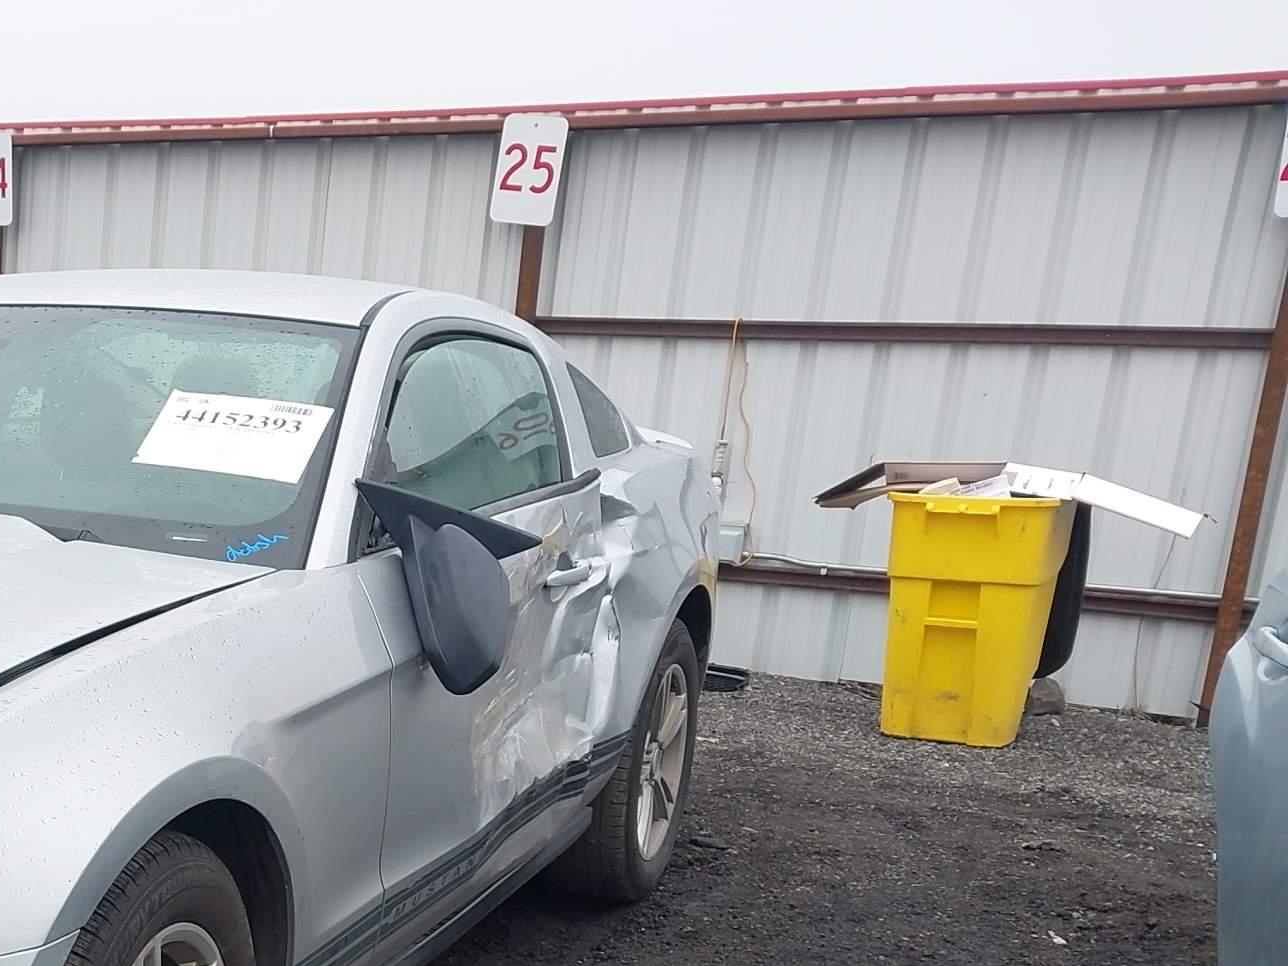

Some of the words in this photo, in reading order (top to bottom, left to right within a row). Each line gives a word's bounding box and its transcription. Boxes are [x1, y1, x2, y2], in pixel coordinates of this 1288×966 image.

[499, 143, 558, 194] 25
[175, 408, 304, 434] 44152393
[392, 852, 481, 919] MUSTAN
